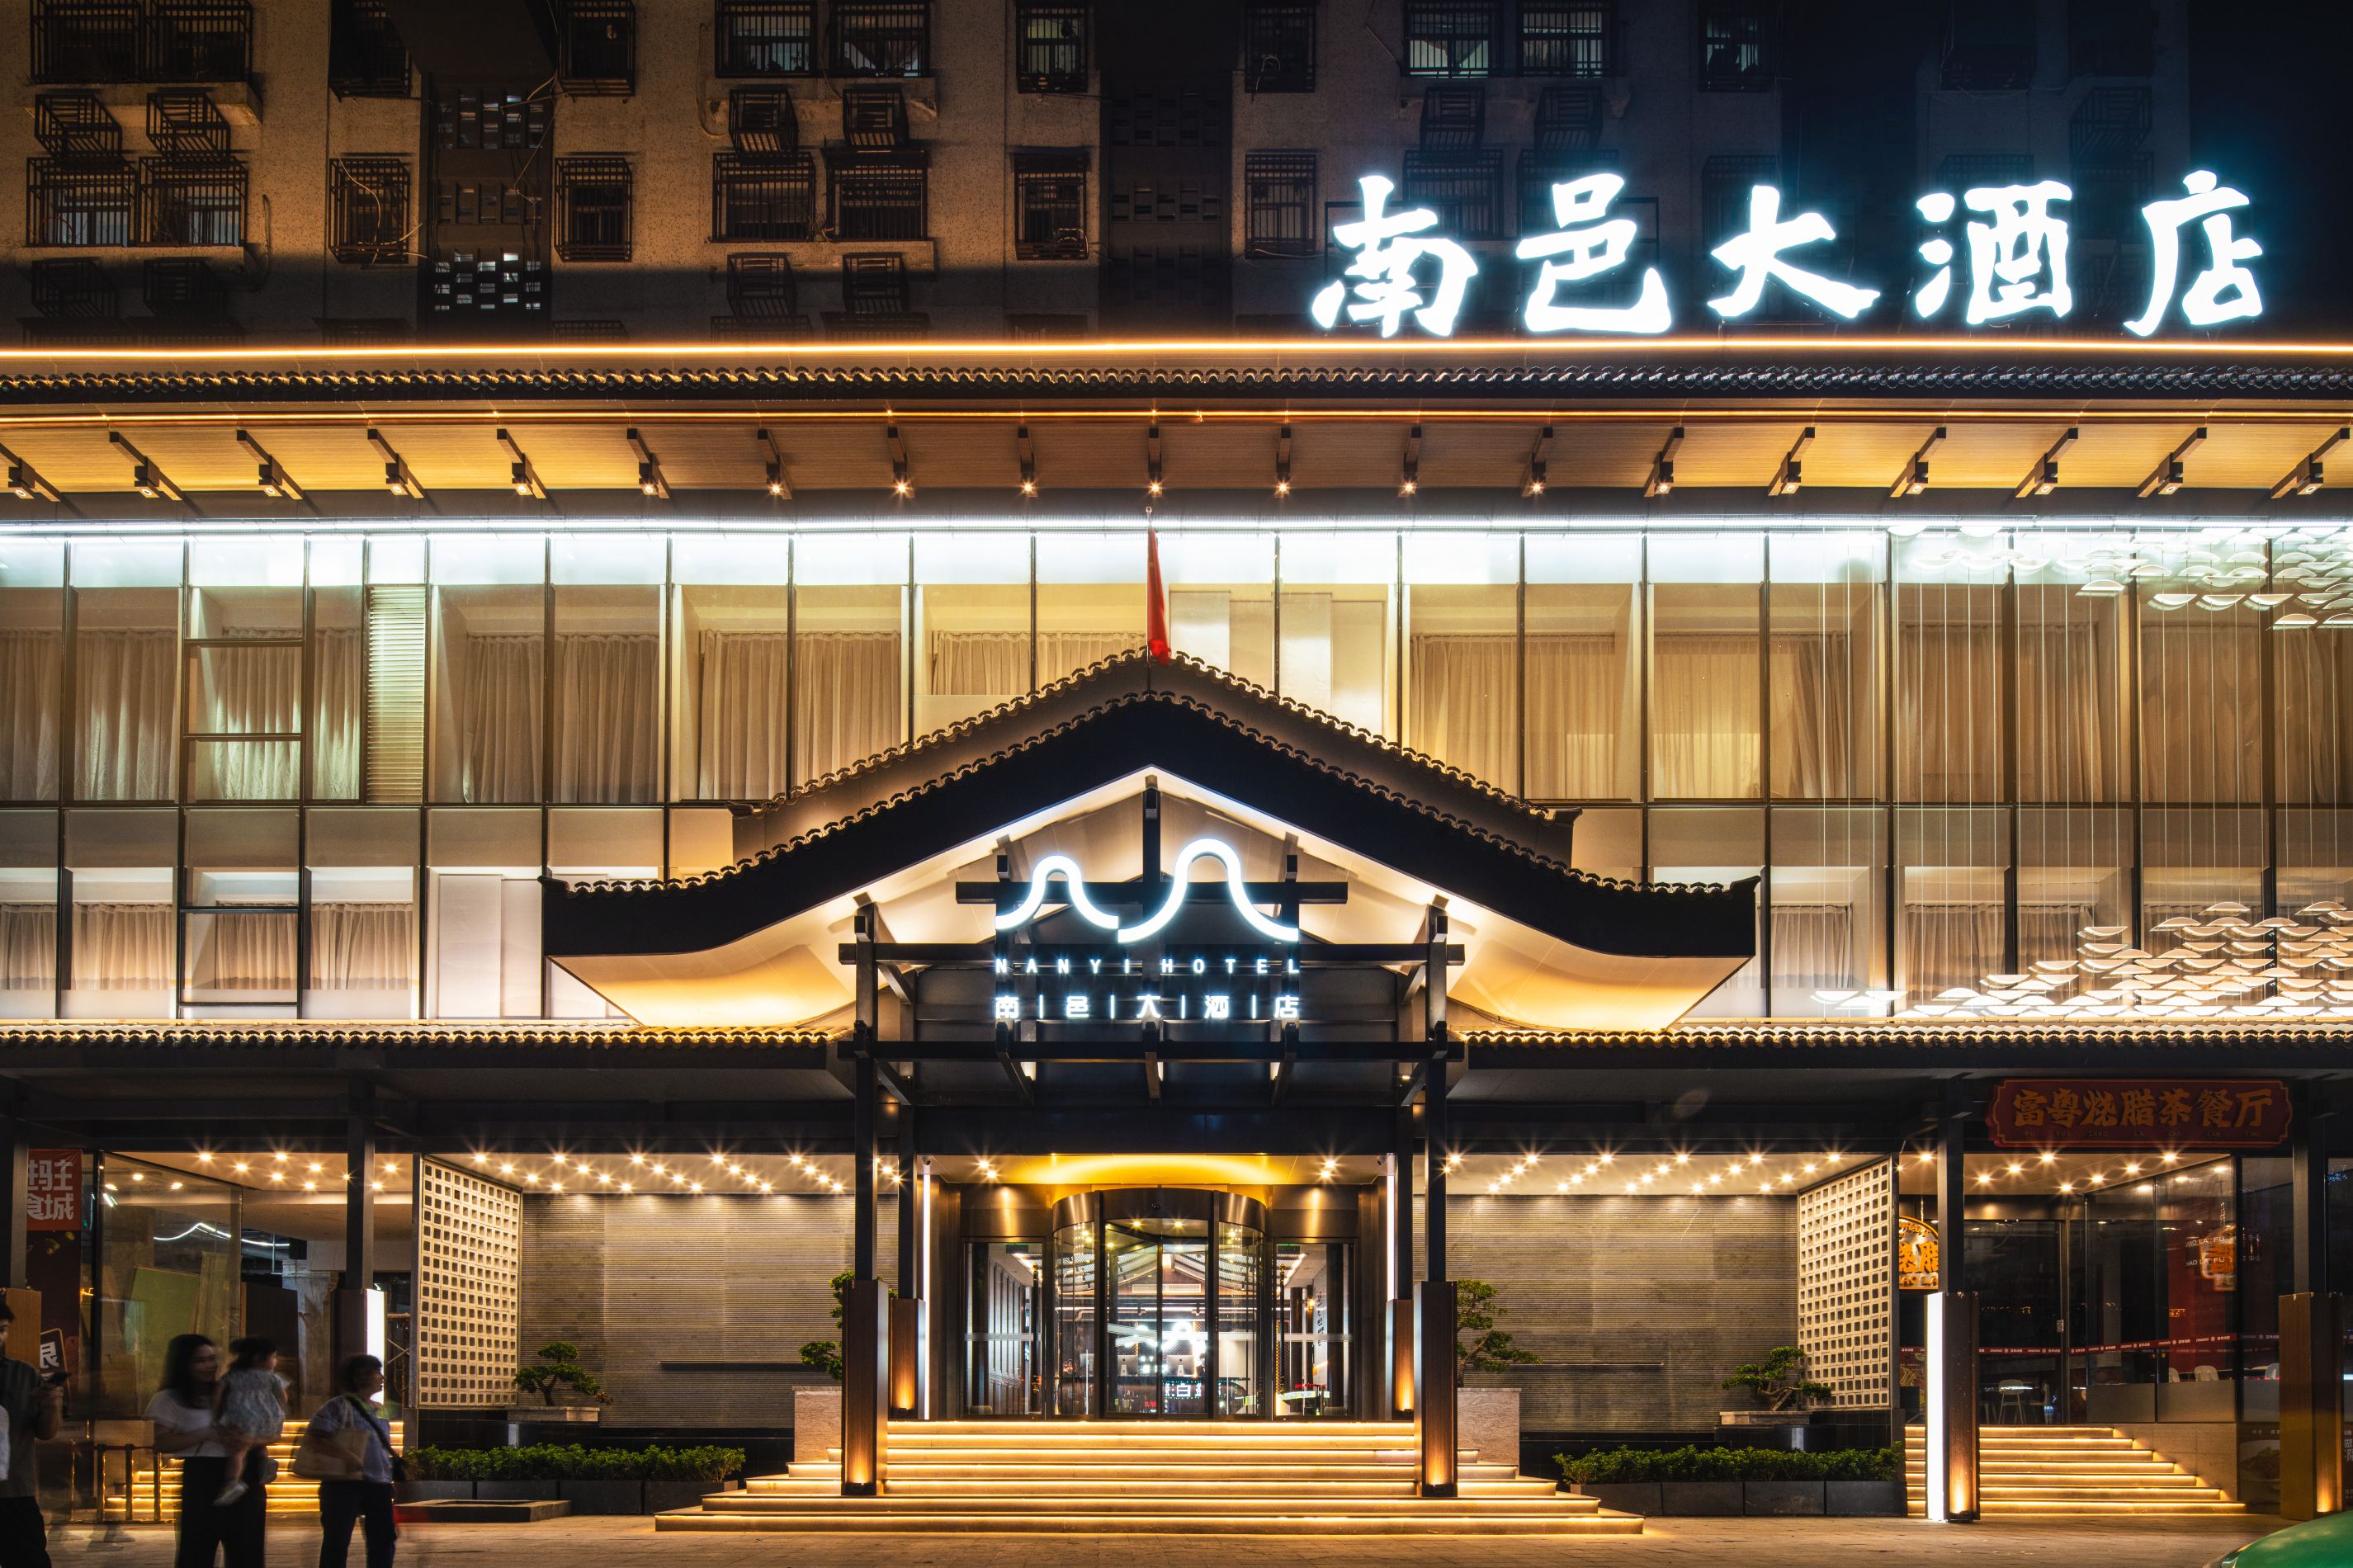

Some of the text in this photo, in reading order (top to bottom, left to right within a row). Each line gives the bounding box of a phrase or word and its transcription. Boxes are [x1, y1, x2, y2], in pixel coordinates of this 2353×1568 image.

[1311, 170, 2265, 337] 南邑大酒店
[995, 959, 1299, 974] NANYI HOTEL
[2013, 1088, 2273, 1128] 富粤烧腊茶餐厅
